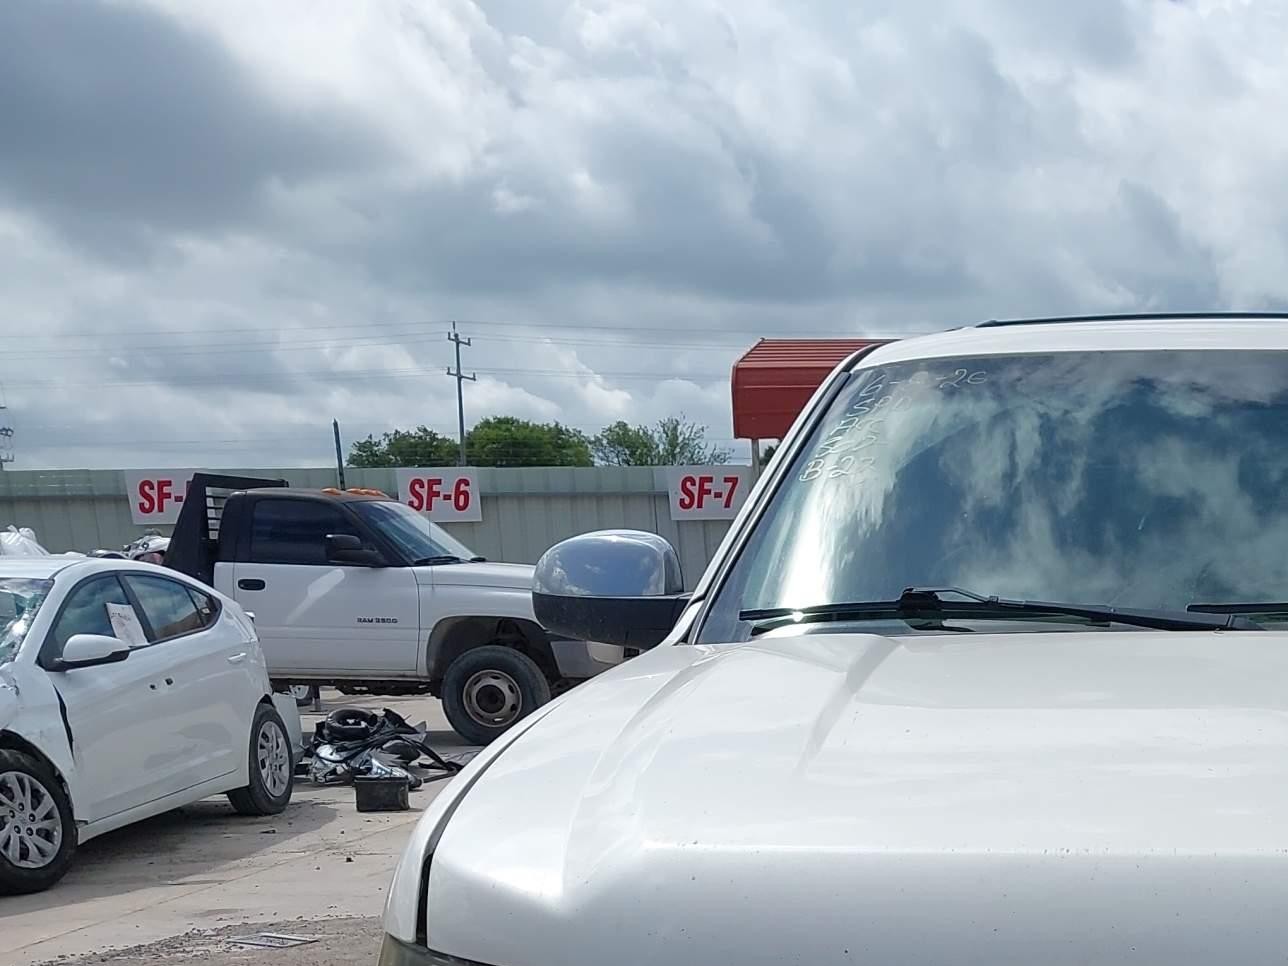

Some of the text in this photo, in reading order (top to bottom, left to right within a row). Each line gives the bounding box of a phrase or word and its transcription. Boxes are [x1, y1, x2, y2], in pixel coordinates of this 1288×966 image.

[138, 479, 193, 514] SF-
[409, 478, 471, 512] SF-6
[678, 476, 740, 510] SF-7
